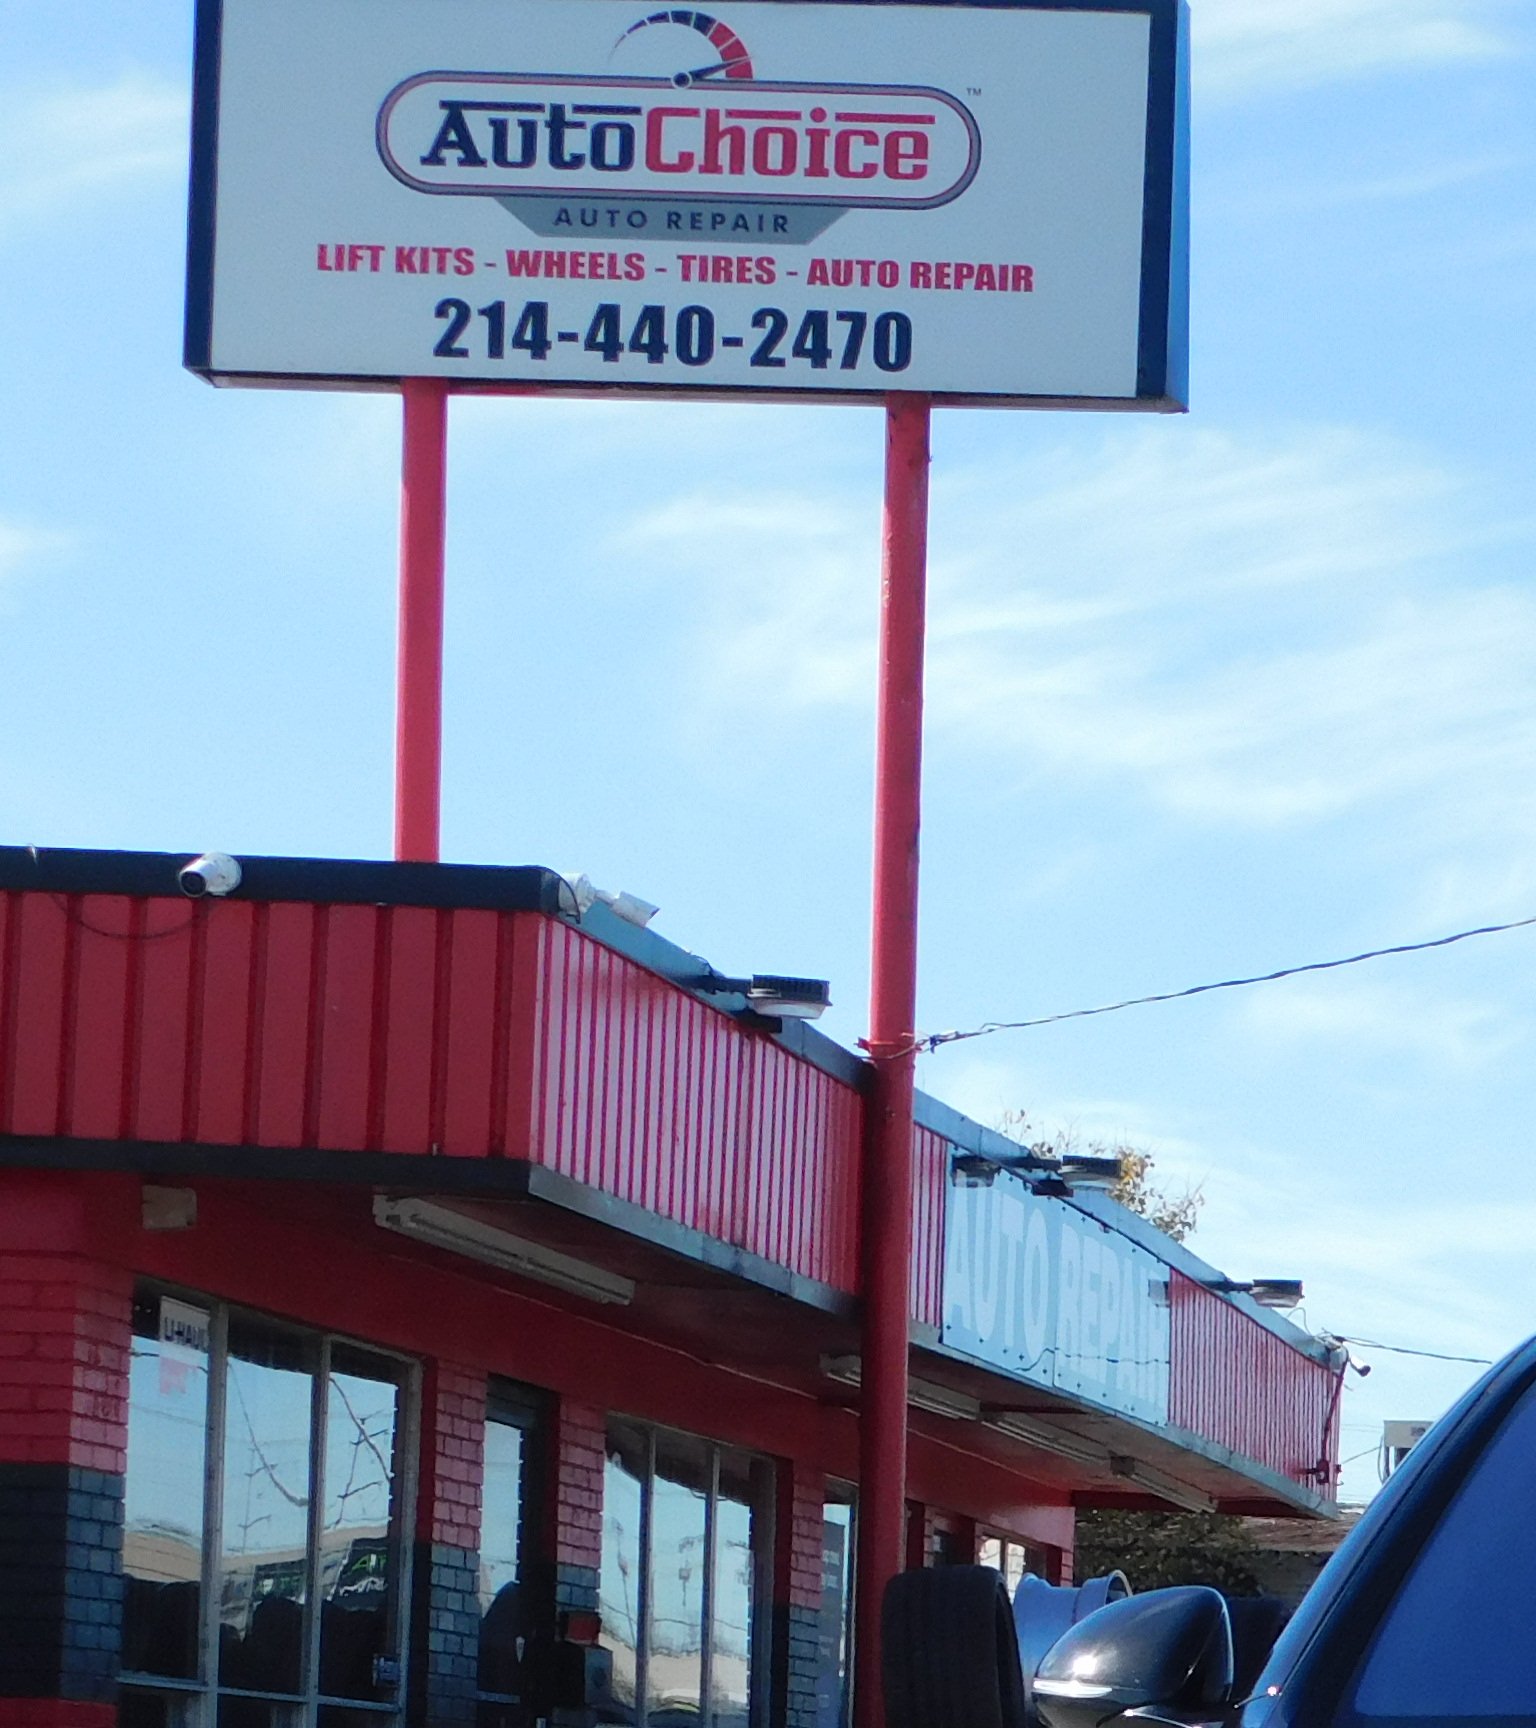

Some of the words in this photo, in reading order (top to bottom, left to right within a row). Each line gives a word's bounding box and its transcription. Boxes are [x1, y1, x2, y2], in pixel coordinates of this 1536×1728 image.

[420, 100, 935, 180] AutoChoice
[553, 207, 648, 229] AUTO
[666, 210, 790, 234] REPAIR
[317, 243, 386, 272] LIFT
[395, 246, 475, 276] KITS
[506, 249, 645, 281] WHEELS
[677, 254, 776, 285] TIRES
[806, 258, 900, 289] AUTO
[909, 261, 1034, 293] REPAIR
[432, 297, 913, 372] 214-440-2470
[945, 1168, 1049, 1362] AUTO
[1055, 1223, 1169, 1410] REPAIR
